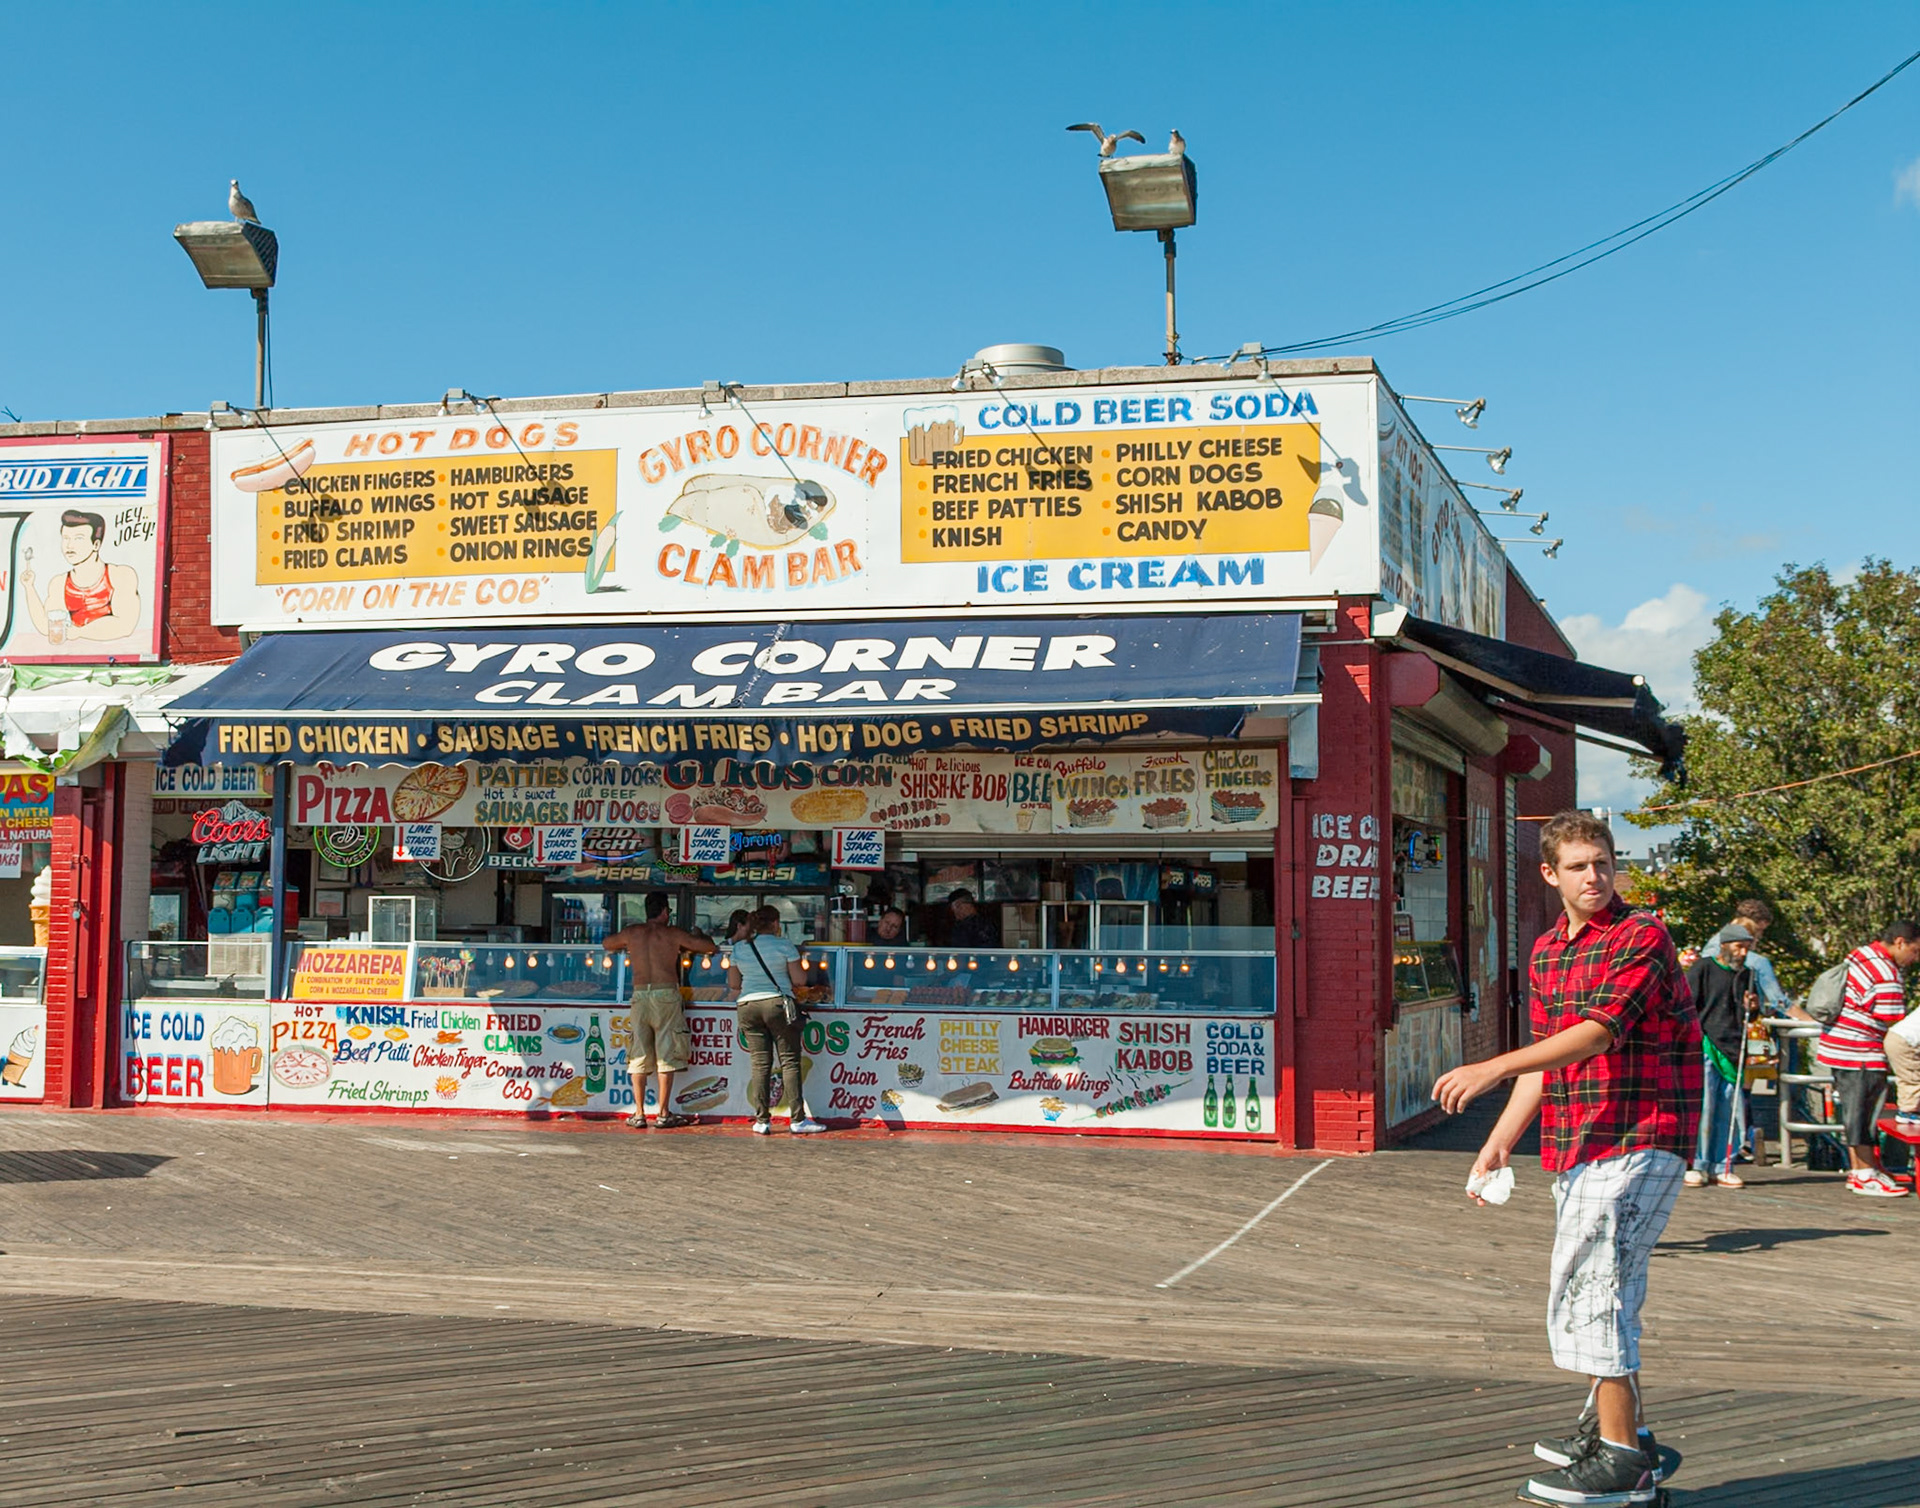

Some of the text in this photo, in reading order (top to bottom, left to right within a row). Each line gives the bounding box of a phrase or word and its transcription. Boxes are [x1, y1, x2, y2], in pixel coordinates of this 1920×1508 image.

[978, 392, 1319, 429] COLD BEER SODA
[344, 422, 580, 456] HOT DOGS
[1116, 438, 1282, 461] PHILLY CHEESE
[639, 423, 887, 488] GYRO CORNER
[932, 445, 1093, 469] FRIED CHICKEN
[0, 465, 148, 490] BUD LIGHT
[284, 470, 435, 495] CHICKEN FINGERS
[450, 463, 574, 486] HAMBURGERS
[932, 470, 1092, 494] FRENCH FRIES
[1116, 463, 1262, 487] CORN DOGS
[284, 493, 435, 518] BUFFALO WINGS
[450, 487, 588, 511] HOT SAUSAGE
[932, 497, 1082, 520] BEEF PATTIES
[1116, 489, 1282, 513] SHISH KABOB
[114, 522, 155, 547] JOEY!
[283, 519, 414, 543] FRIED SHRIMP
[450, 511, 597, 536] SWEET SAUSAGE
[1116, 518, 1207, 542] CANDY
[932, 527, 1002, 547] KNISH
[283, 545, 407, 569] FRIED CLAMS
[450, 537, 593, 562] ONION RINGS
[658, 539, 862, 589] CLAM BAR
[977, 558, 1264, 593] ICE CREAM
[275, 576, 550, 613] "CORN ON THE COB"
[369, 634, 1116, 677] GYRO CORNER
[474, 678, 957, 709] CLAM BAR
[218, 712, 1149, 755] FRIED CHICKEN SAUSAGE FRENCH FRIES HOT DOG FRIED SHRIMP
[911, 757, 928, 772] HOT
[936, 757, 981, 773] Delicious
[1014, 757, 1034, 767] ICE
[1053, 756, 1106, 778] Buffalo
[1142, 750, 1190, 768] French
[1203, 750, 1258, 771] Chicken
[156, 765, 255, 791] ICE COLD BEER
[476, 766, 568, 787] PATTIES
[572, 767, 662, 786] CORN DOGS
[818, 764, 893, 788] CORN
[1054, 774, 1129, 800] WINGS
[1133, 768, 1196, 796] FRIES
[1205, 770, 1272, 789] FINGERS
[298, 775, 391, 823] PIZZA
[484, 788, 556, 800] Hot sweet
[600, 788, 637, 799] BEEF
[14, 807, 48, 818] WITH
[475, 801, 569, 825] SAUSAGES
[573, 800, 660, 823] HOT DOGS
[191, 807, 271, 844] Coors
[409, 825, 433, 834] LINE
[548, 828, 574, 838] LINE
[587, 828, 635, 839] BUD
[694, 828, 720, 838] LINE
[846, 831, 877, 841] LINE
[1312, 814, 1352, 839] ICE
[404, 835, 437, 845] STARTS
[408, 846, 436, 857] HERE
[544, 839, 577, 849] STARTS
[690, 839, 726, 848] STARTS
[843, 842, 882, 852] STARTS
[196, 842, 269, 864] LIGHT
[547, 850, 577, 861] HERE
[693, 850, 725, 860] HERE
[847, 853, 879, 865] HERE
[595, 867, 651, 880] PEPSI
[297, 952, 403, 975] MOZZAREPA
[307, 976, 400, 986] COMBINATION SWEET GROUND
[367, 987, 388, 996] CHEESE
[294, 1005, 323, 1018] HOT
[411, 1011, 480, 1031] Fried Chicken
[486, 1014, 541, 1032] FRIED
[125, 1010, 205, 1041] ICE COLD
[272, 1020, 338, 1052] PIZZA
[720, 1019, 732, 1033] OR
[856, 1015, 926, 1040] French
[940, 1020, 1000, 1037] PHILLY
[1018, 1017, 1110, 1039] HAMBURGER
[1119, 1022, 1191, 1045] SHISH
[1206, 1022, 1264, 1040] COLD
[334, 1039, 412, 1063] Beef Patti
[484, 1035, 542, 1054] CLAMS
[858, 1038, 909, 1062] Fries
[940, 1038, 1000, 1054] CHEESE
[413, 1045, 454, 1068] Chicken
[940, 1056, 1000, 1072] STEAK
[1117, 1048, 1193, 1072] KABOB
[1206, 1056, 1265, 1075] BEER
[126, 1052, 204, 1098] BEER
[486, 1061, 522, 1078] Corn
[526, 1065, 545, 1078] on
[549, 1061, 574, 1079] the
[830, 1062, 879, 1086] Onion
[329, 1079, 429, 1107] Fried Shrimps
[502, 1079, 533, 1100] Cob
[1008, 1070, 1111, 1099] Buffalo Wings
[829, 1087, 876, 1118] Rings
